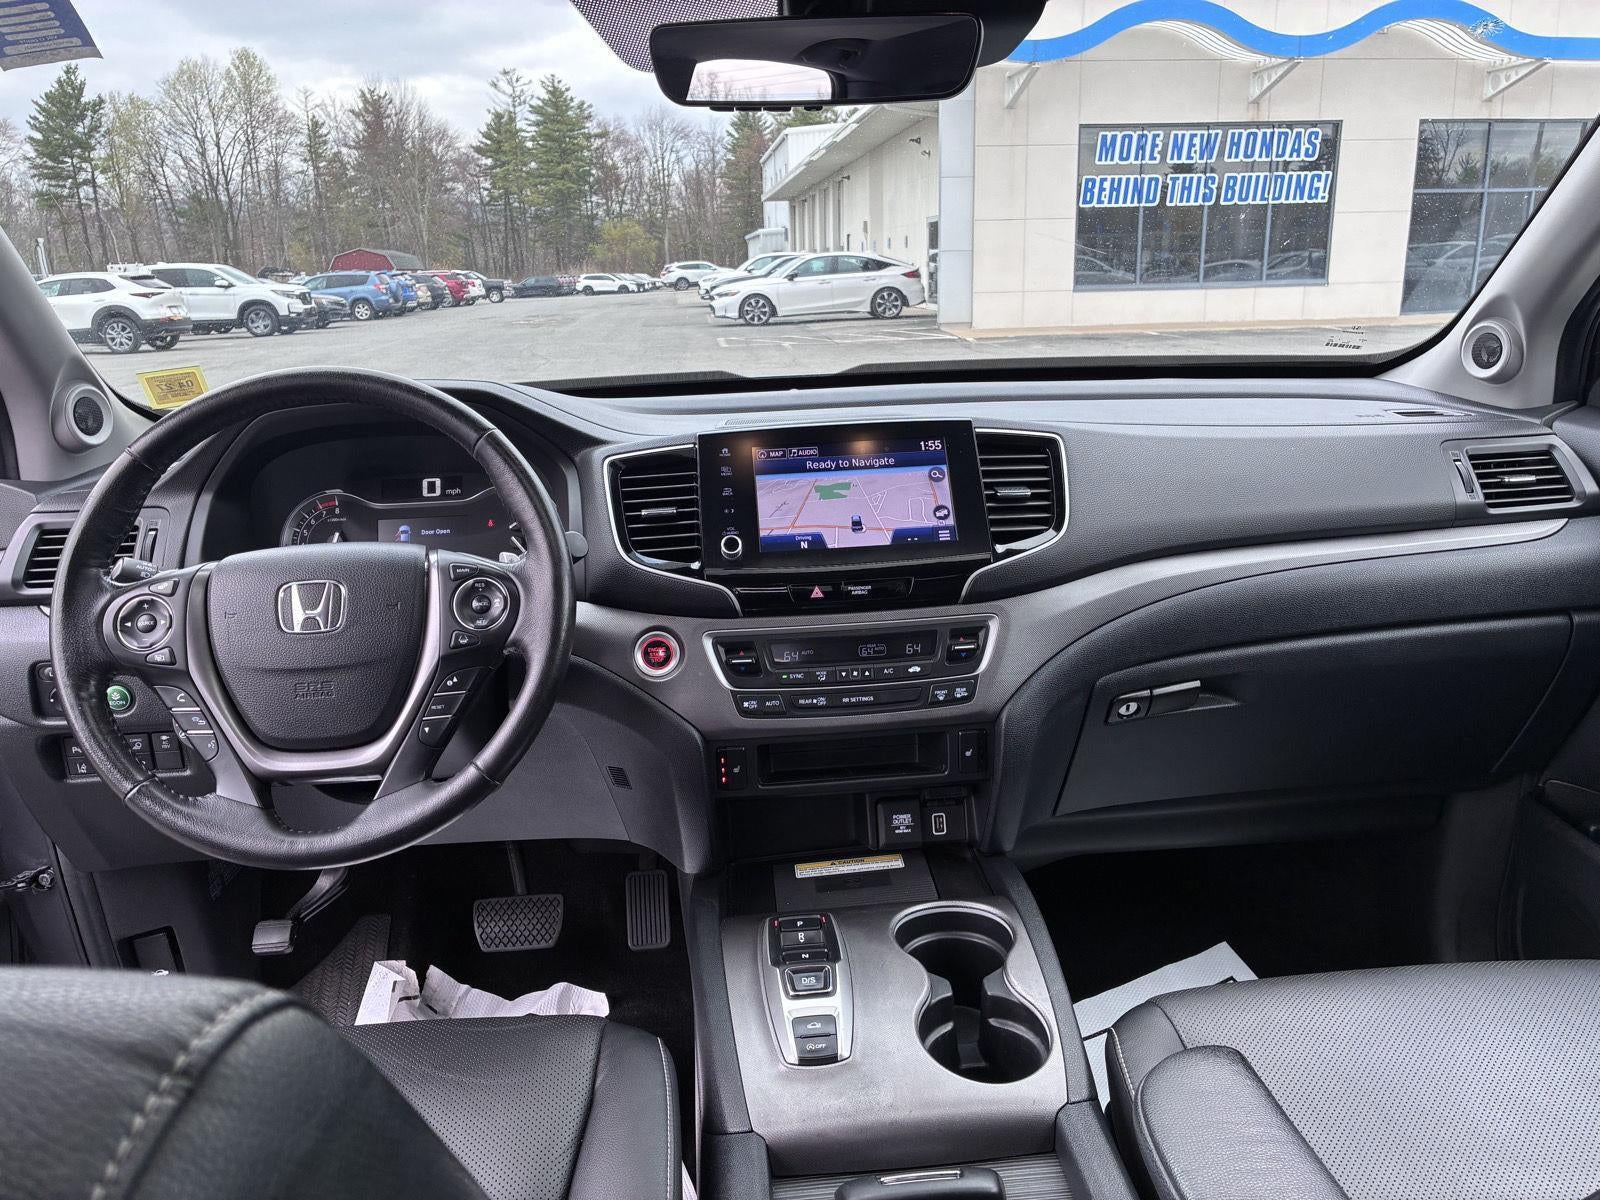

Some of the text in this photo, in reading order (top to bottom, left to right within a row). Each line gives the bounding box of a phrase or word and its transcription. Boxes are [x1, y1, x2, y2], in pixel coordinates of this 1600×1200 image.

[1095, 128, 1322, 164] MORE NEW HONDAS
[1079, 171, 1333, 207] BEHIND THIS BUILDING!
[919, 440, 942, 451] 1:55
[769, 450, 784, 459] MAP
[798, 448, 818, 457] AUDIO
[806, 456, 895, 471] Ready to Navigate
[422, 478, 461, 497] 0 mph
[795, 535, 812, 543] Driving
[800, 541, 808, 550] N
[905, 643, 921, 655] 64
[783, 651, 800, 662] 64
[837, 858, 865, 866] CAUTION
[796, 920, 804, 928] P
[798, 932, 805, 941] R
[801, 976, 816, 985] D/S
